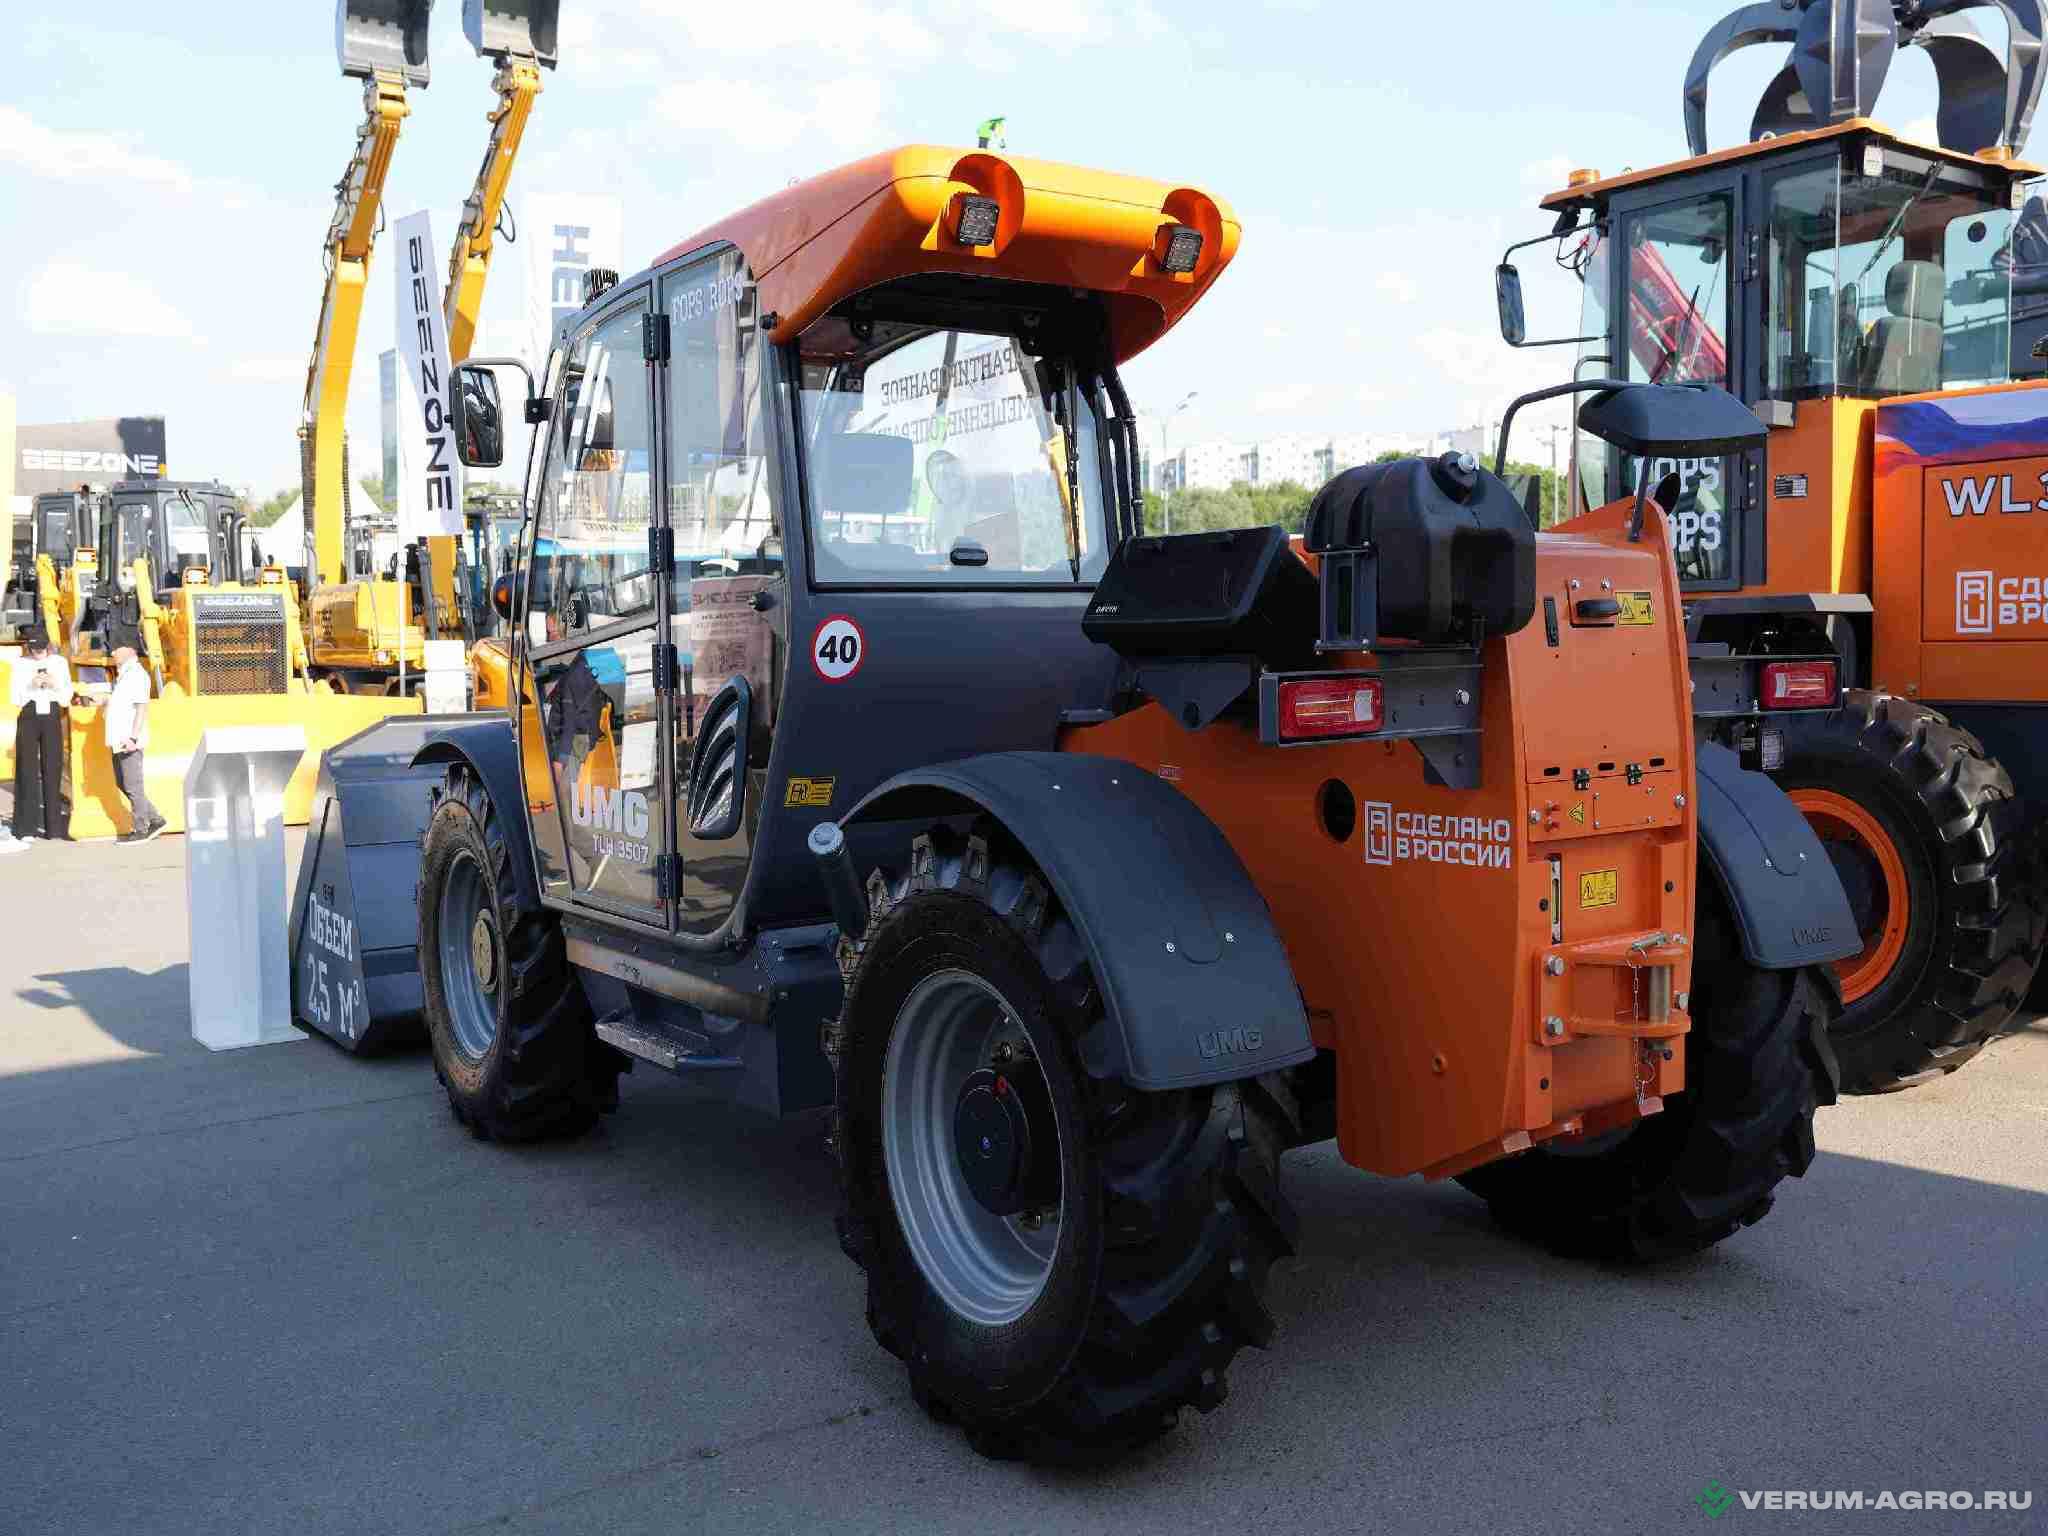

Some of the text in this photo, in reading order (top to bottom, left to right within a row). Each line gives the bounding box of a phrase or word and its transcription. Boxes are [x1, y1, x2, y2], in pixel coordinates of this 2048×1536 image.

[1999, 577, 2048, 602] СД
[819, 636, 857, 664] 40
[571, 782, 649, 838] UMG
[1396, 812, 1511, 842] СДЕЛАНО
